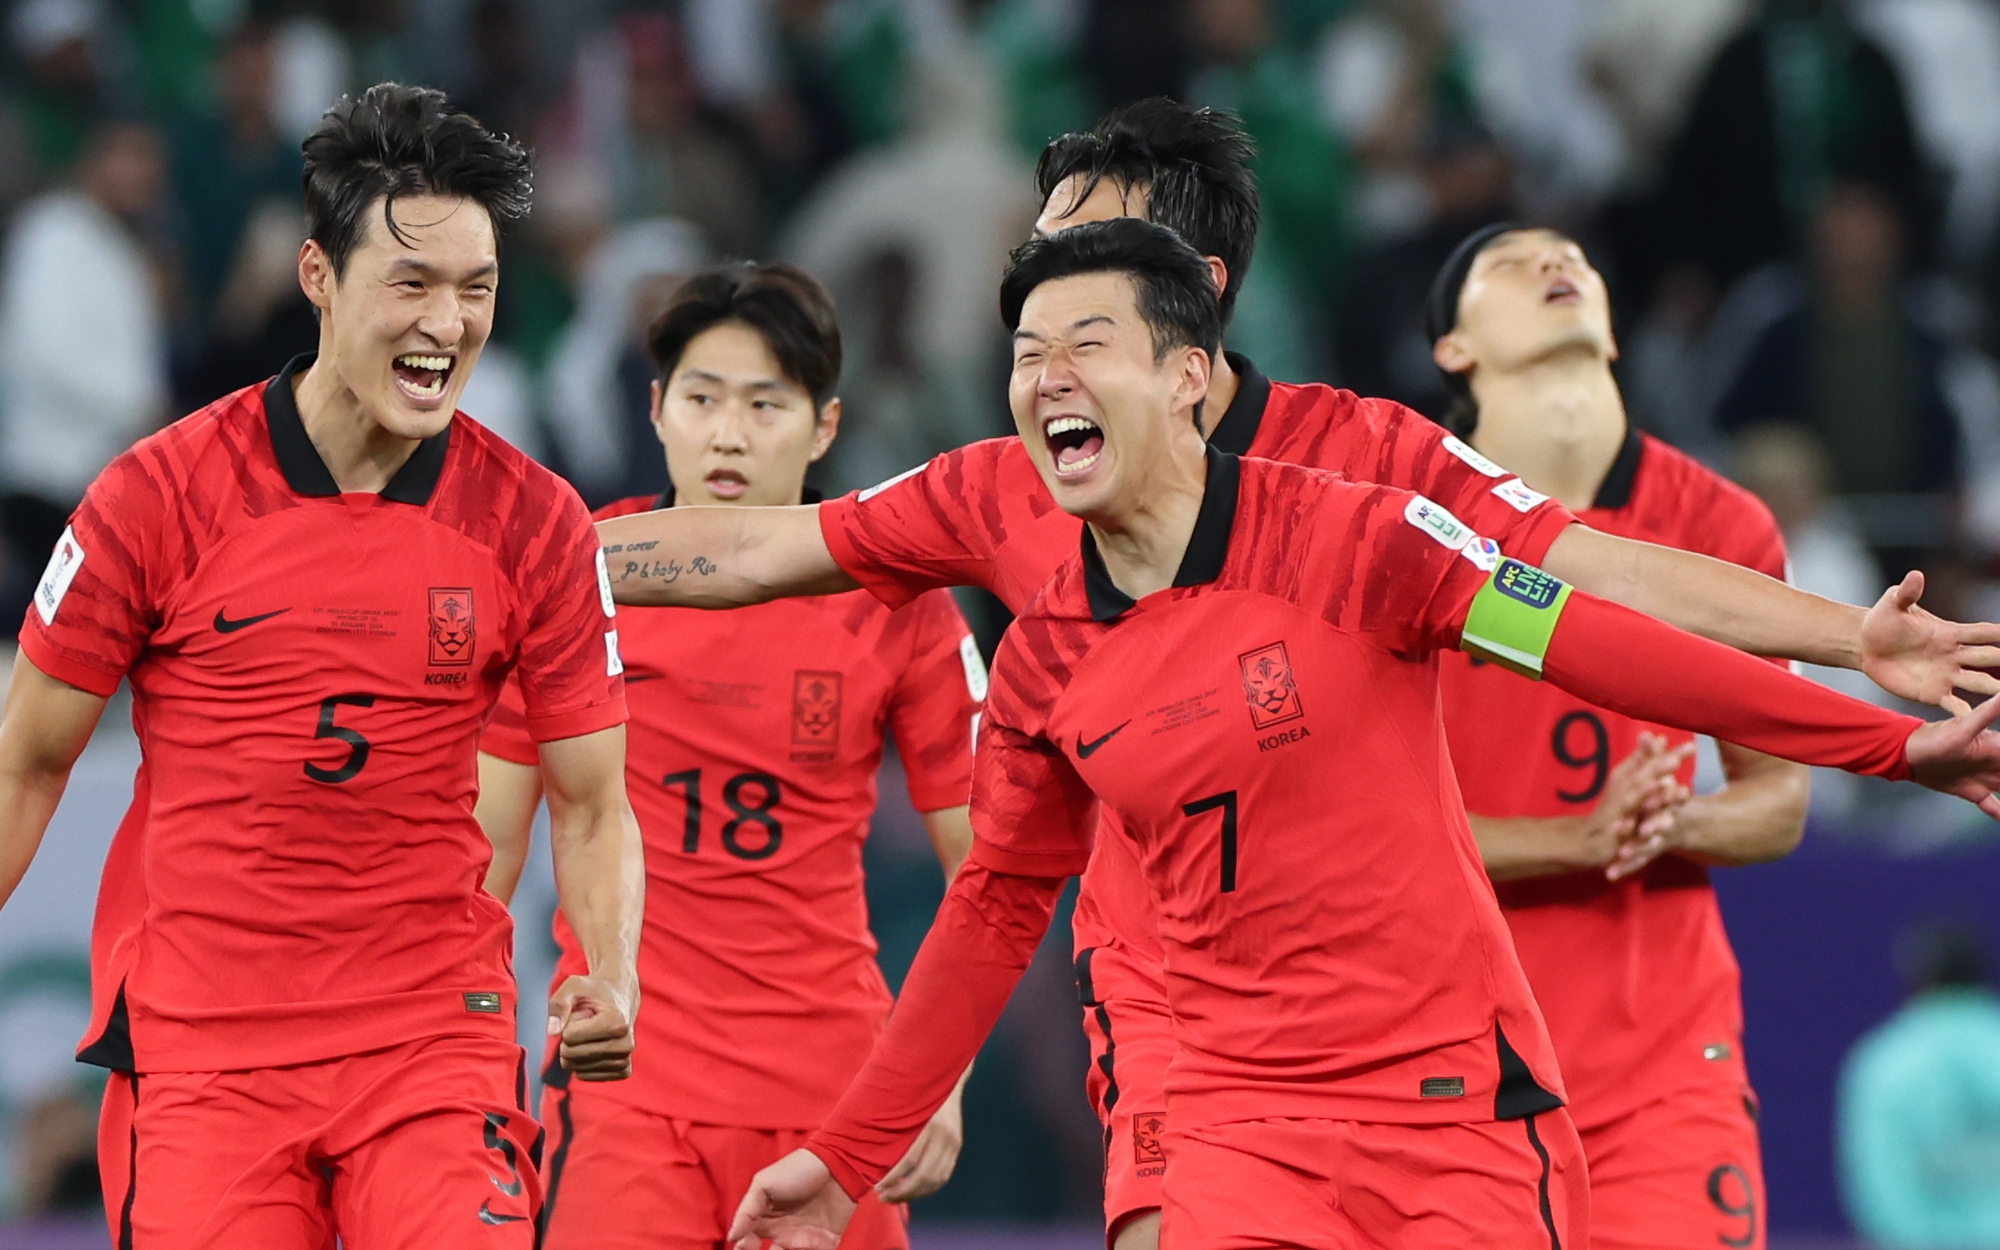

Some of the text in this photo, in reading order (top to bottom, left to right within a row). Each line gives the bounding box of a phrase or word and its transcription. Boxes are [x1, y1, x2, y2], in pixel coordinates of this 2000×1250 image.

[1417, 504, 1433, 520] AF
[621, 561, 639, 580] P
[652, 559, 683, 583] baby
[687, 556, 717, 576] Ria
[1501, 565, 1520, 588] AFC
[424, 673, 467, 685] KOREA
[303, 692, 377, 784] 5
[1257, 726, 1311, 752] KOREA
[1553, 709, 1609, 804] 9
[662, 768, 783, 861] 18
[1181, 790, 1237, 893] 7
[484, 1112, 522, 1198] 5
[1136, 1166, 1165, 1179] KORE
[1708, 1165, 1756, 1249] 9
